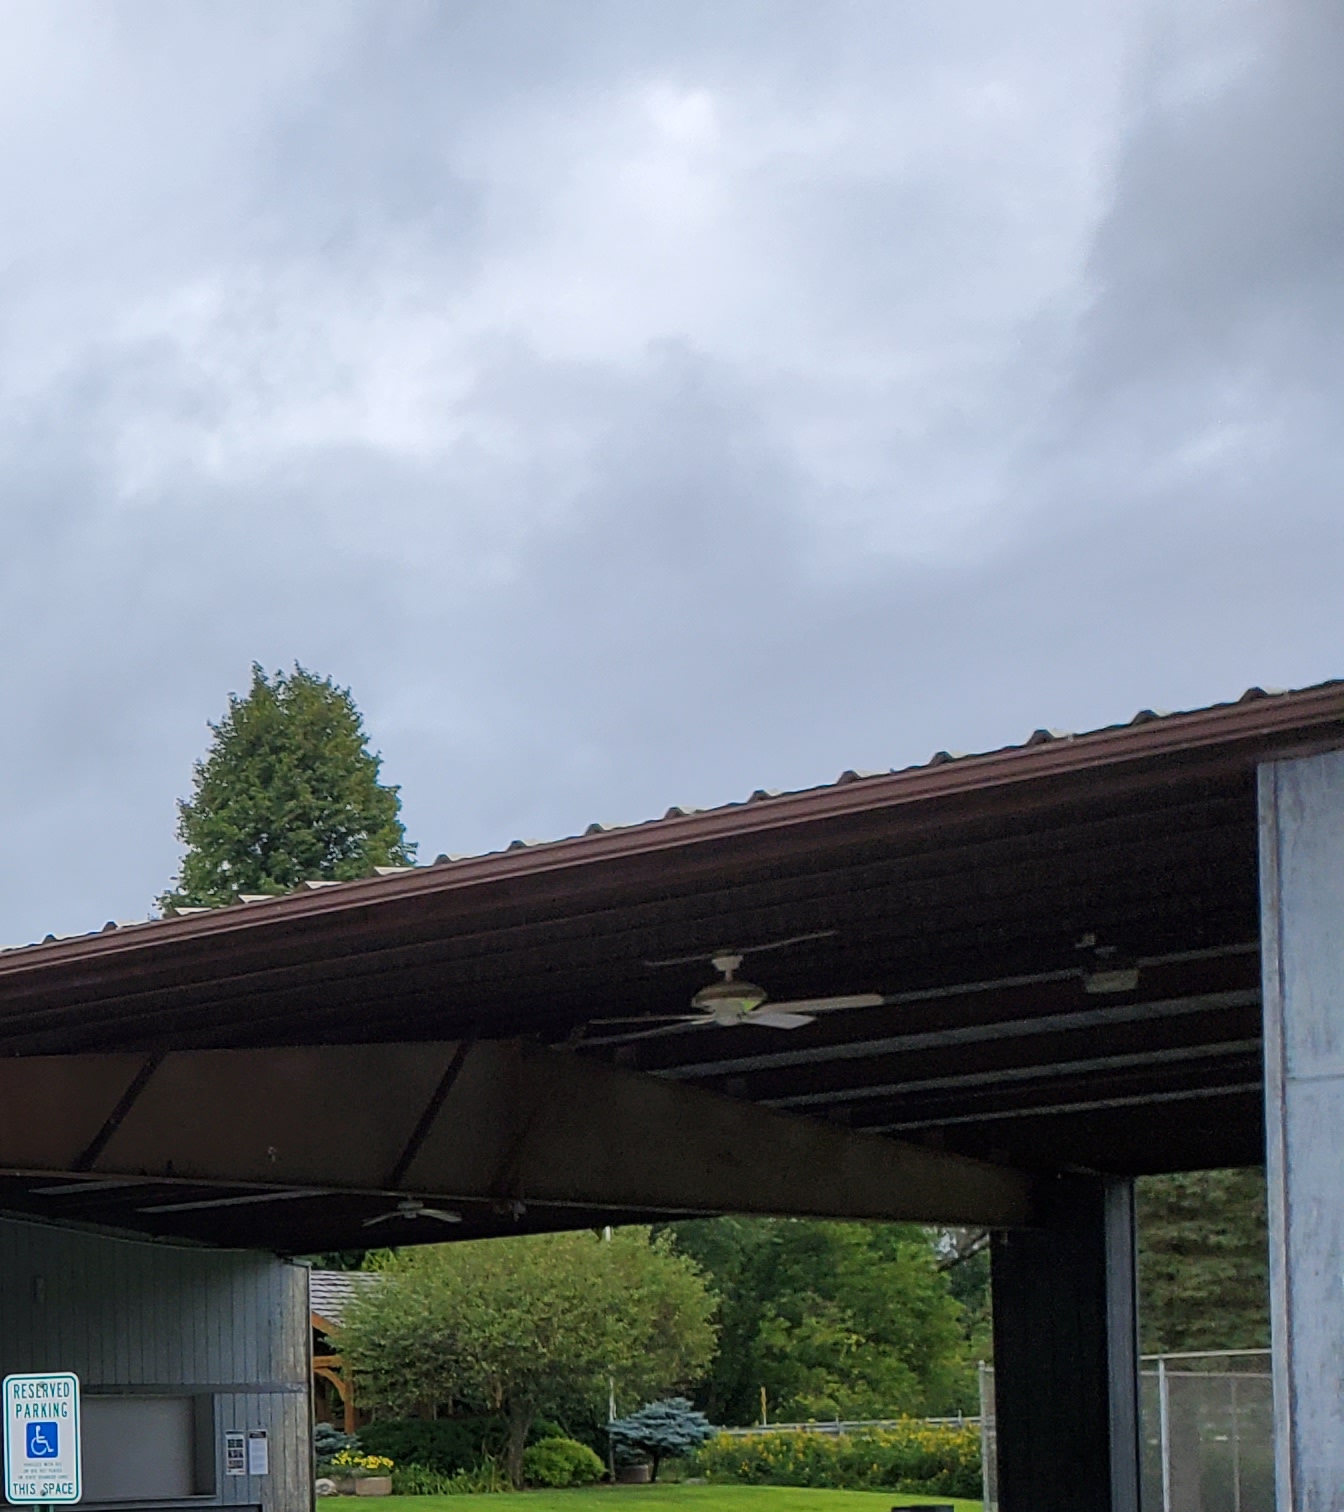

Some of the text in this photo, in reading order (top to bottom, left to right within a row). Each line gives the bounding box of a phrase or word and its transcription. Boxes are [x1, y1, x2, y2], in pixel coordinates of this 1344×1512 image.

[13, 1382, 70, 1399] RESERVED
[15, 1402, 68, 1419] PARKING
[13, 1483, 74, 1495] THIS SPACE
